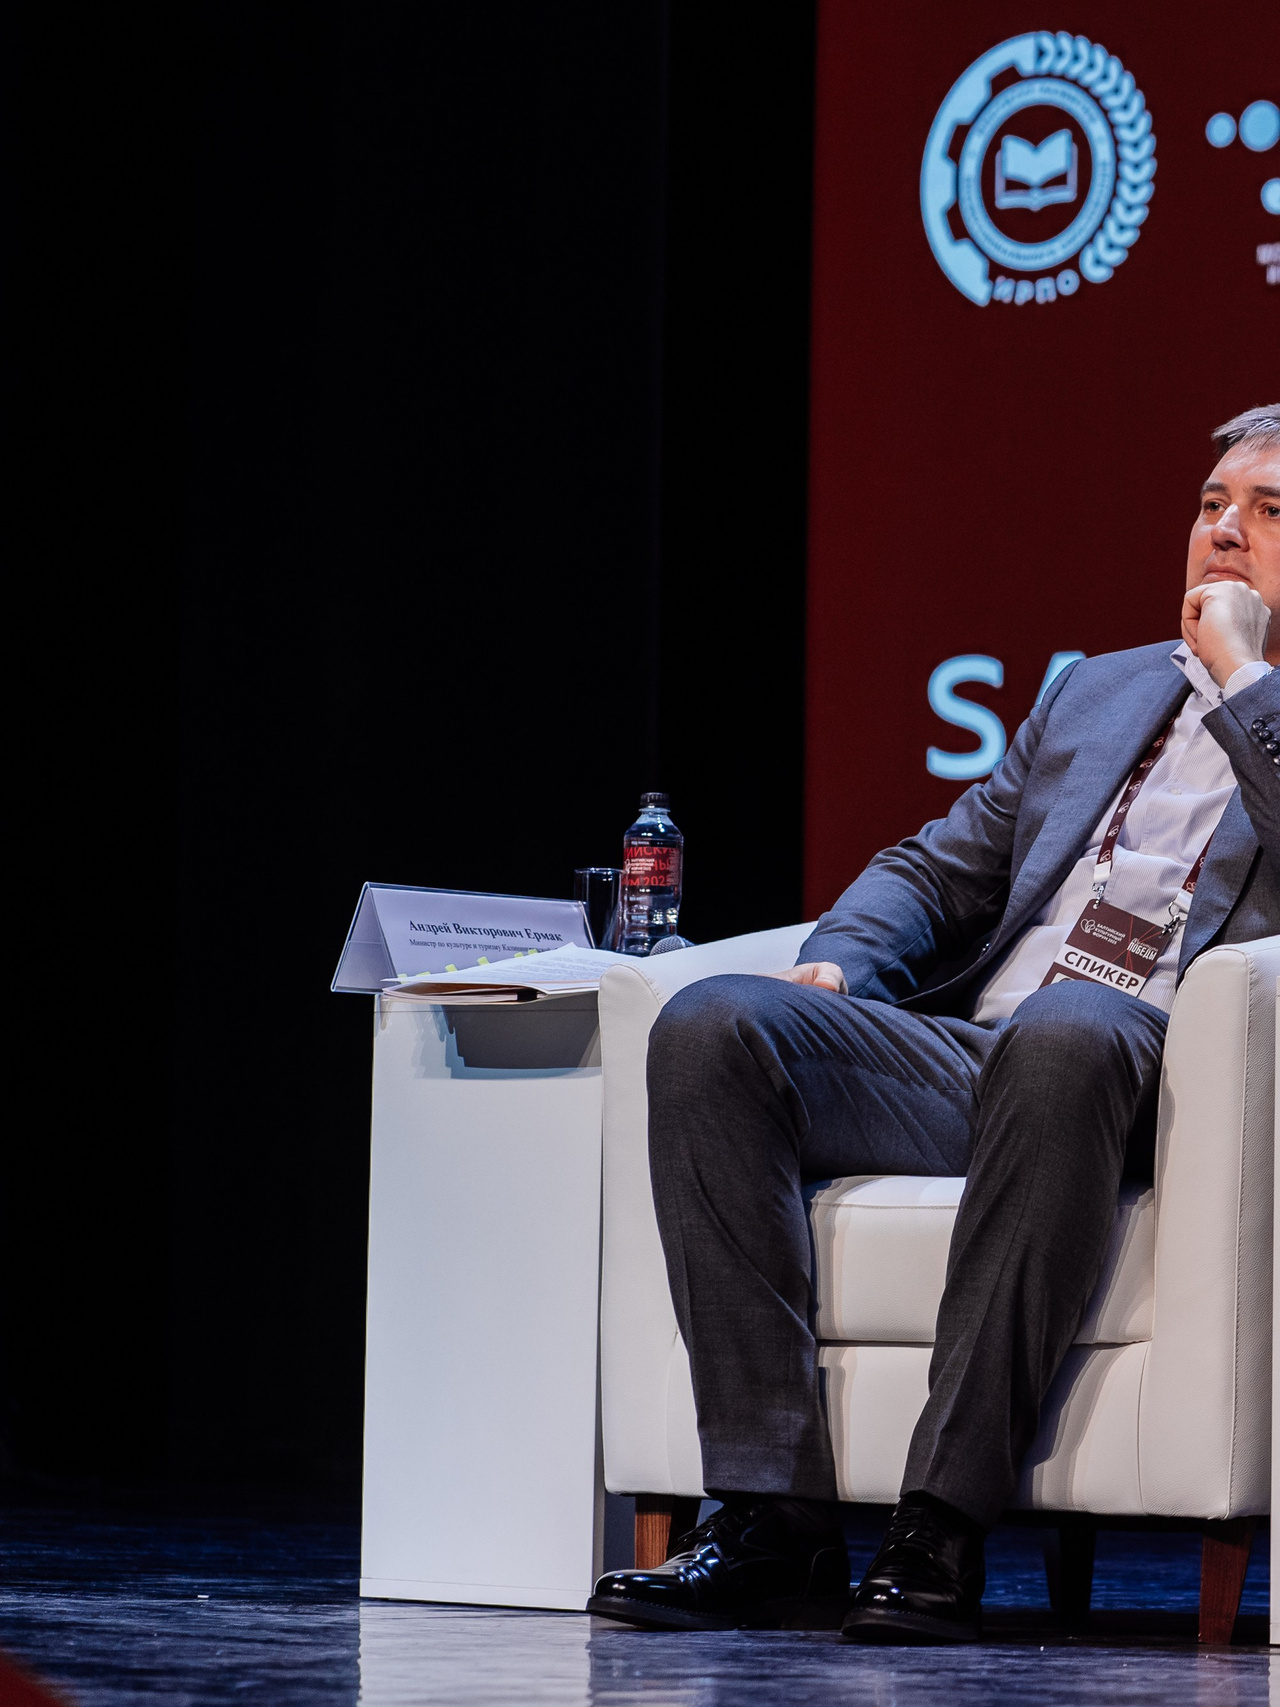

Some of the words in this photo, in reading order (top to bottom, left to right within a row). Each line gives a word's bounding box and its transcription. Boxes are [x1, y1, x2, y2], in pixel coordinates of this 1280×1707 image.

[992, 269, 1080, 306] ИРПО
[410, 920, 452, 935] Андрей
[452, 922, 524, 939] Викторович
[525, 928, 563, 942] Ермак
[409, 939, 437, 949] Министр
[446, 942, 472, 950] культуре
[1127, 941, 1158, 961] ПОБЕДЫ
[1064, 951, 1139, 990] СПИКЕР
